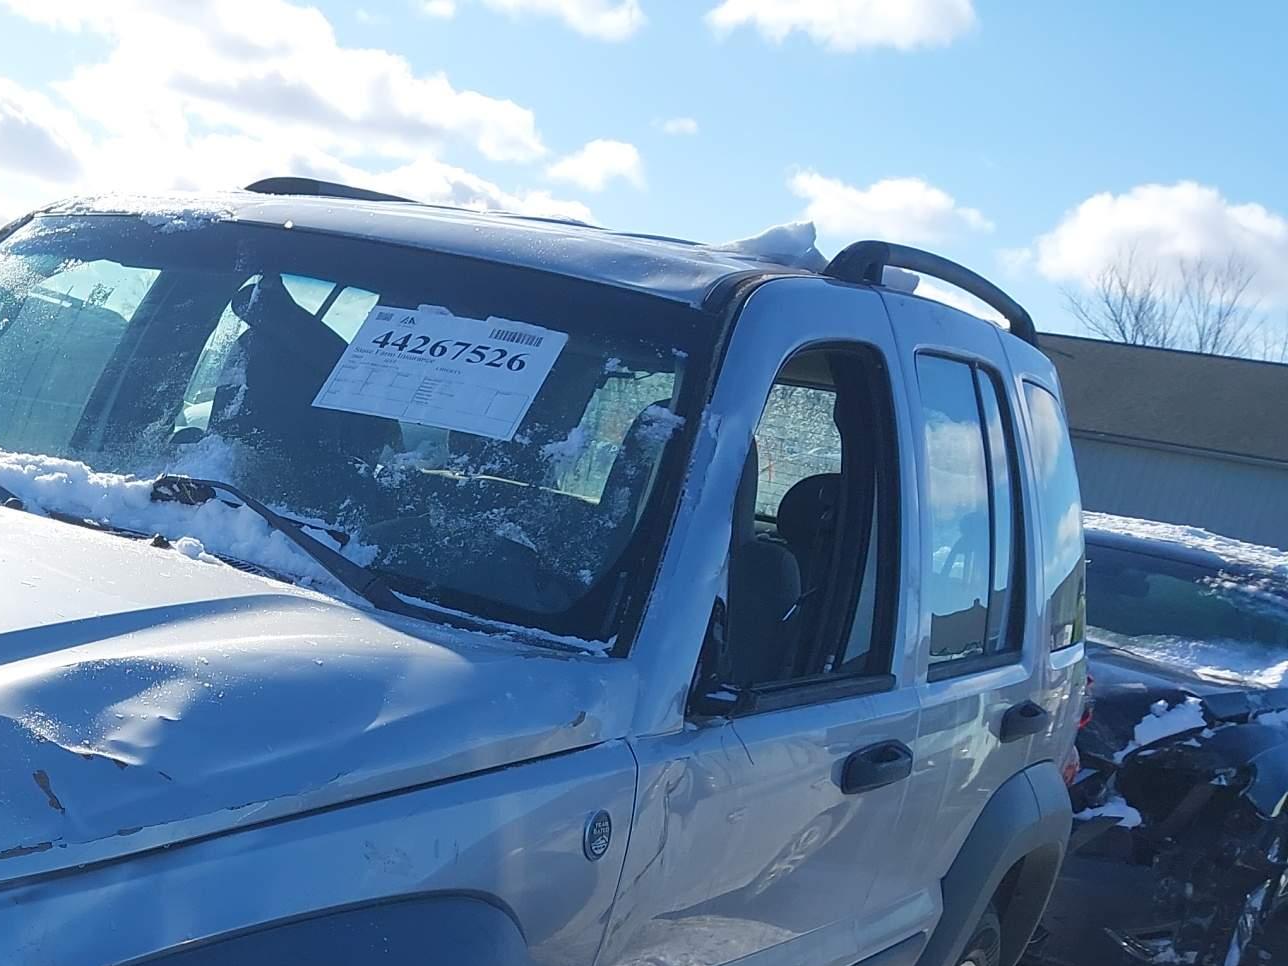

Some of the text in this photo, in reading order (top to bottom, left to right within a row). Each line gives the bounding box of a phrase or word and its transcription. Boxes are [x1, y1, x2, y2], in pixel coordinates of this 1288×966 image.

[371, 329, 530, 373] 44267526
[375, 348, 396, 359] Farm
[397, 351, 436, 365] Insurance
